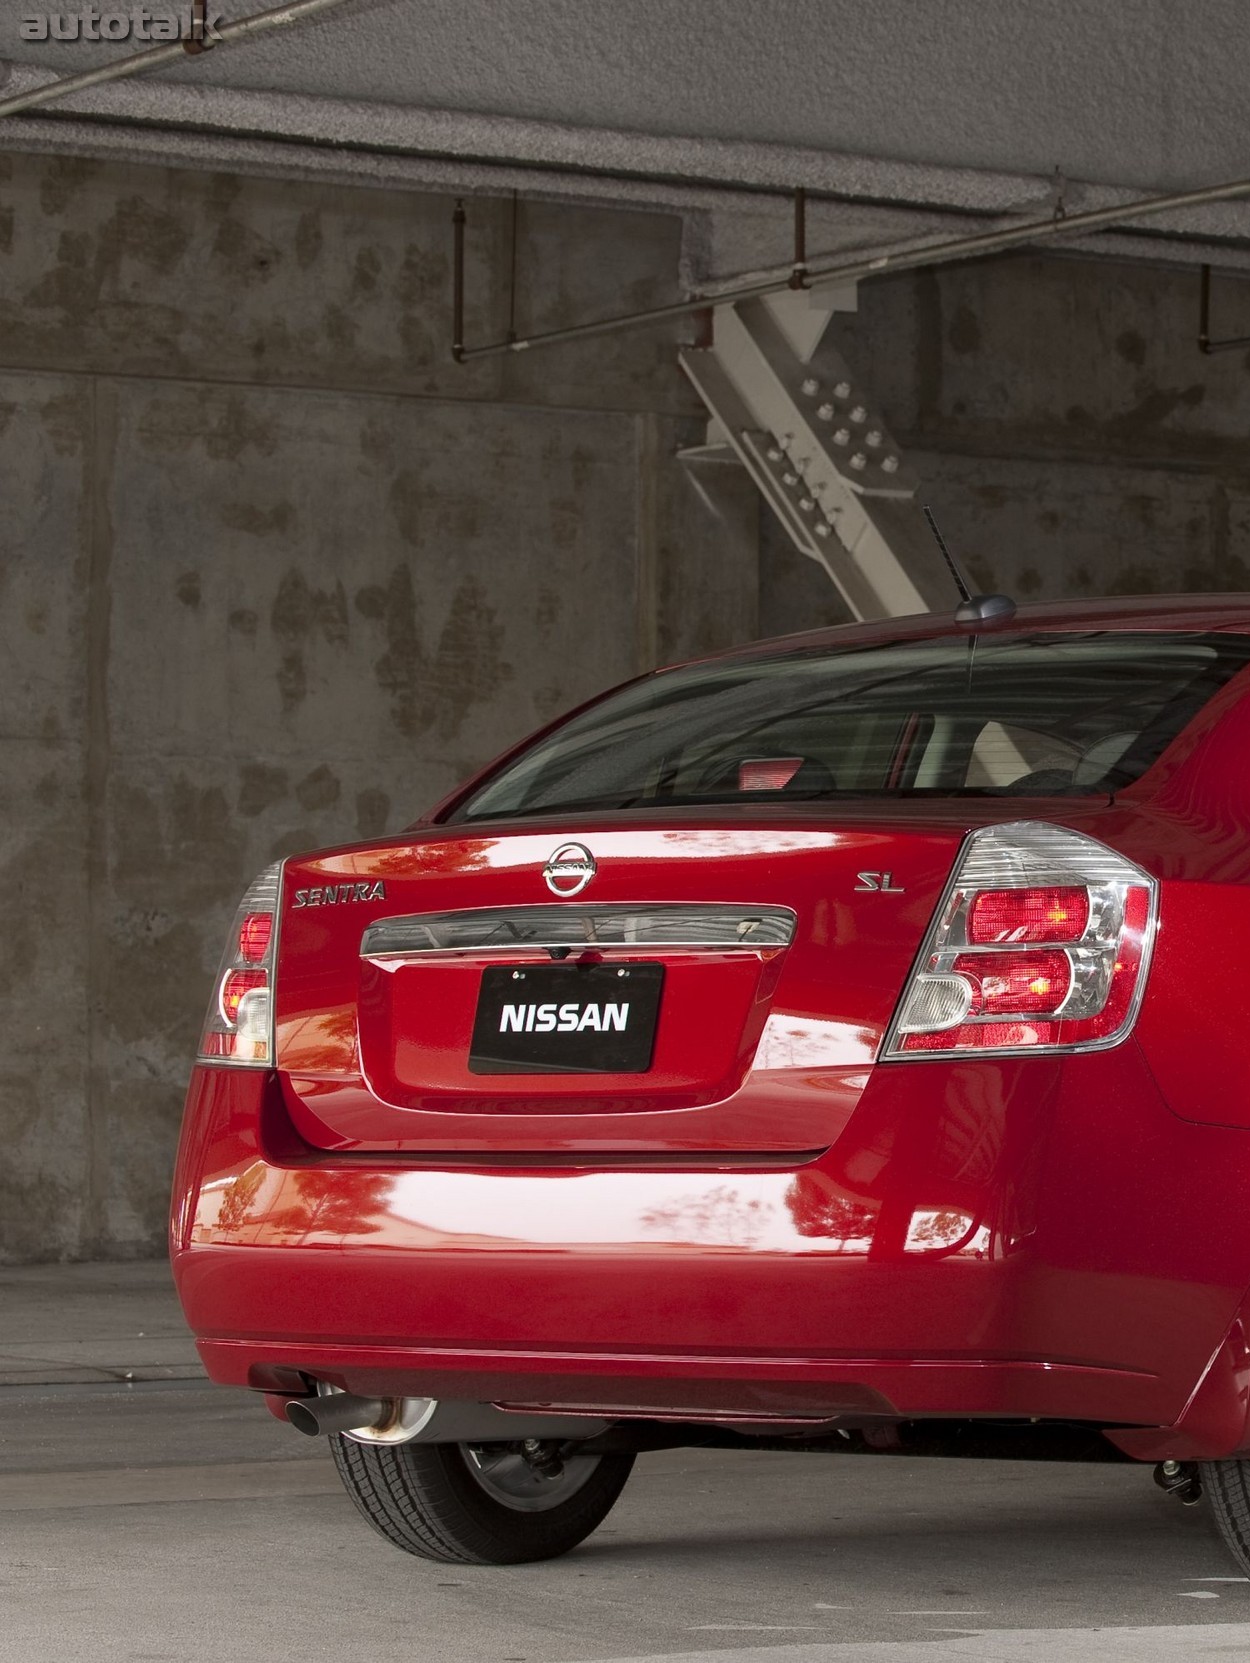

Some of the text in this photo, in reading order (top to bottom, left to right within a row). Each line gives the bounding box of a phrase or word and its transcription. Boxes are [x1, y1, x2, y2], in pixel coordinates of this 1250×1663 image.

[292, 881, 385, 908] SENTRA
[854, 871, 905, 892] SL
[499, 1003, 630, 1033] NISSAN
